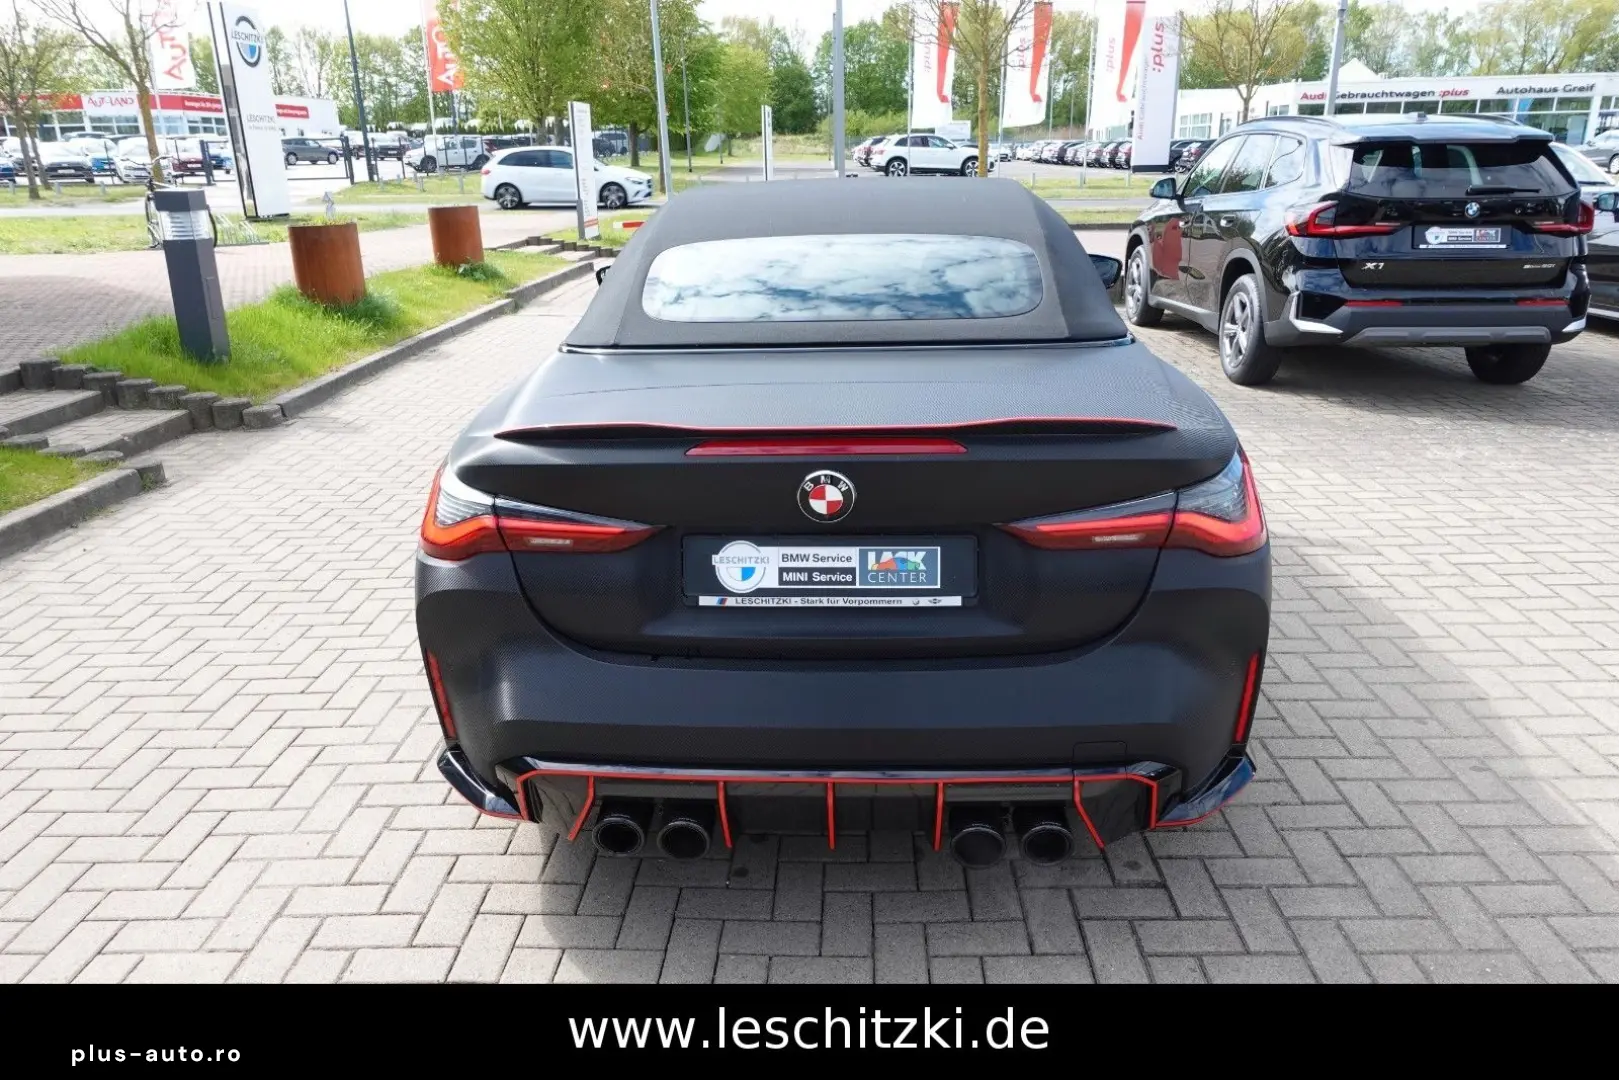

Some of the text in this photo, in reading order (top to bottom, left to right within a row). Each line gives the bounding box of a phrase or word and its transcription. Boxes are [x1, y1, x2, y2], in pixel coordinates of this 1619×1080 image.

[153, 9, 187, 80] AUT
[1151, 20, 1165, 73] :plus
[1105, 37, 1116, 73] :plus
[1335, 88, 1435, 99] Gebrauchtwagen
[1439, 88, 1470, 100] :plus
[1496, 83, 1596, 95] Autohaus Greif
[1361, 262, 1384, 270] X1
[713, 556, 770, 564] LESCHITZKI
[781, 553, 853, 563] BMW Service
[867, 551, 927, 571] LACK
[782, 572, 853, 582] MINI Service
[867, 572, 927, 583] CENTER
[735, 597, 792, 605] LESCHITZKI
[800, 597, 824, 605] Stark
[827, 597, 839, 605] für
[842, 597, 903, 606] Vorpommern
